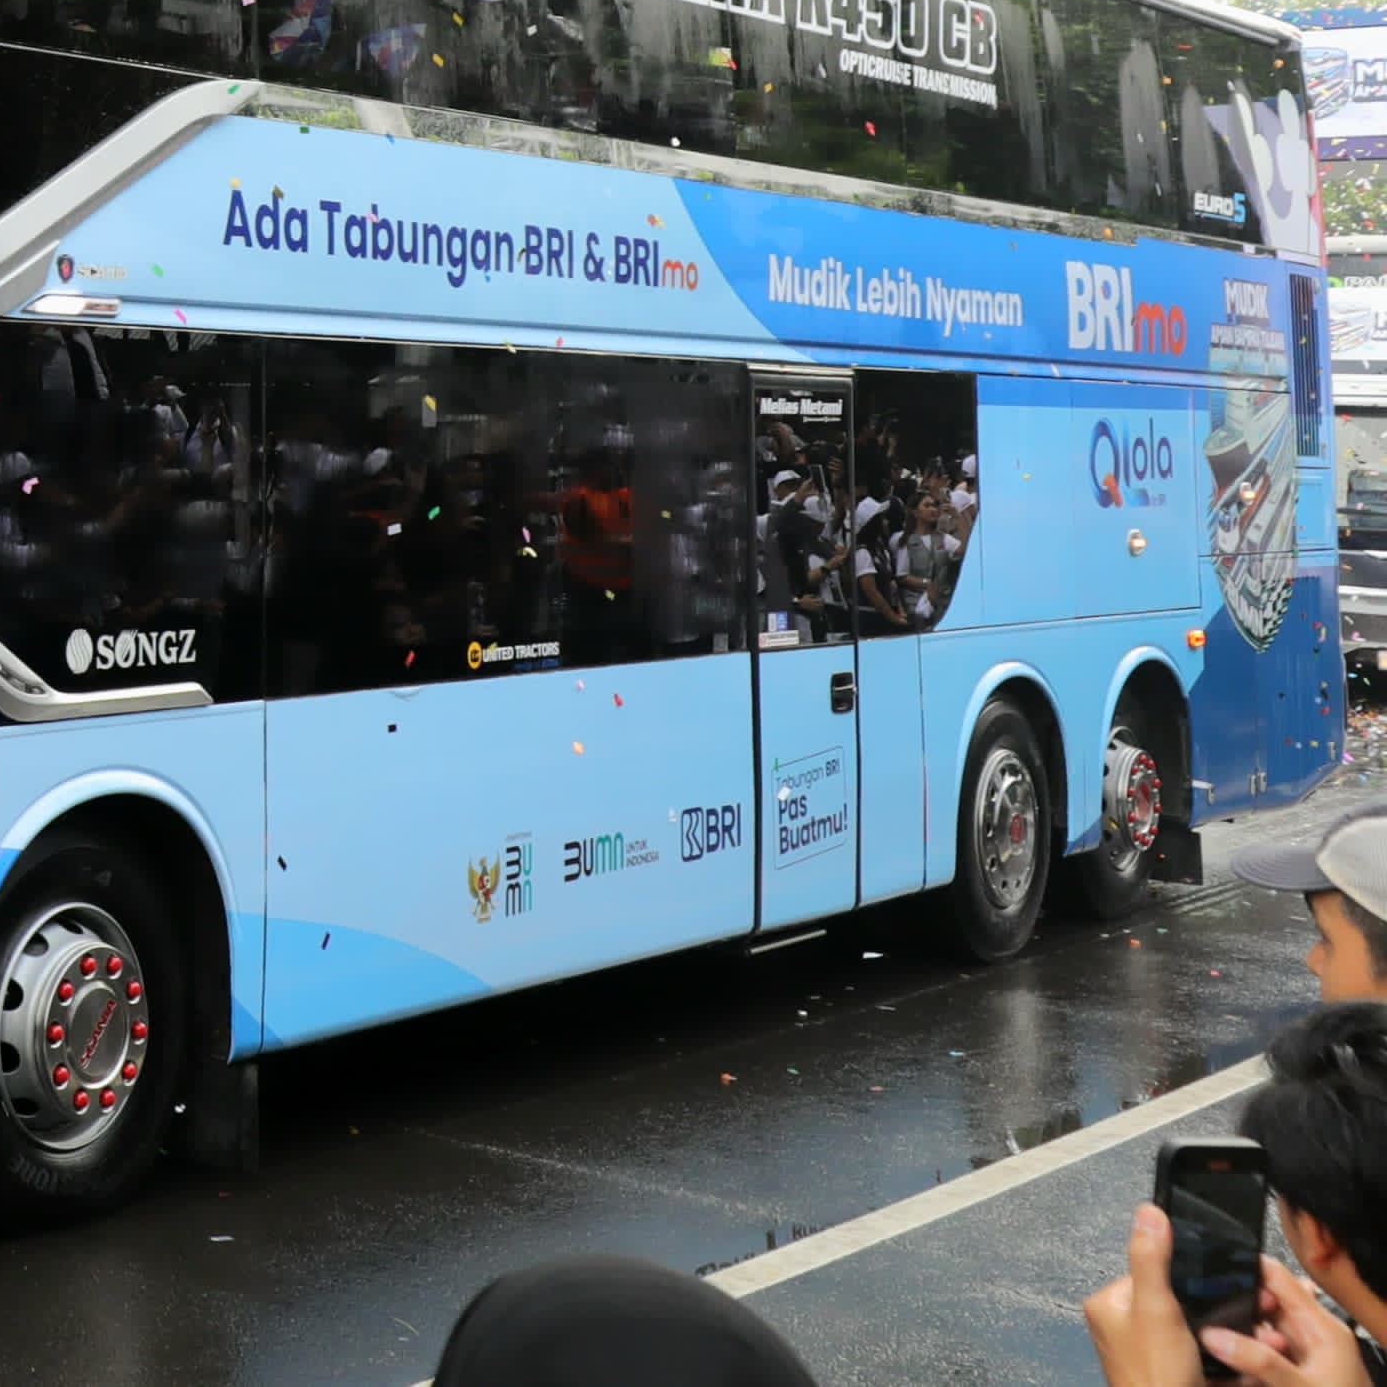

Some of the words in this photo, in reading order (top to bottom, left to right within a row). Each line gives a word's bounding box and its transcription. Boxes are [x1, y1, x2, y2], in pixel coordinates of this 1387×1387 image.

[839, 48, 913, 87] OPTICRUISE
[912, 64, 998, 108] TRANSMISSION
[222, 188, 309, 254] Ada
[319, 199, 515, 289] Tabungan
[523, 224, 574, 280] BRI
[582, 234, 607, 283] &
[613, 235, 700, 292] BRImo
[766, 253, 853, 313] Mudik
[855, 266, 922, 320] Lebih
[925, 276, 1025, 338] Nyaman
[1065, 259, 1188, 357] BRImo
[95, 629, 197, 670] SONGZ
[482, 645, 515, 663] UNITED
[514, 641, 561, 660] TRACTORS
[825, 758, 841, 777] BRI
[705, 802, 742, 854] BRI
[777, 795, 808, 825] Pas
[779, 802, 848, 855] Buatmu!
